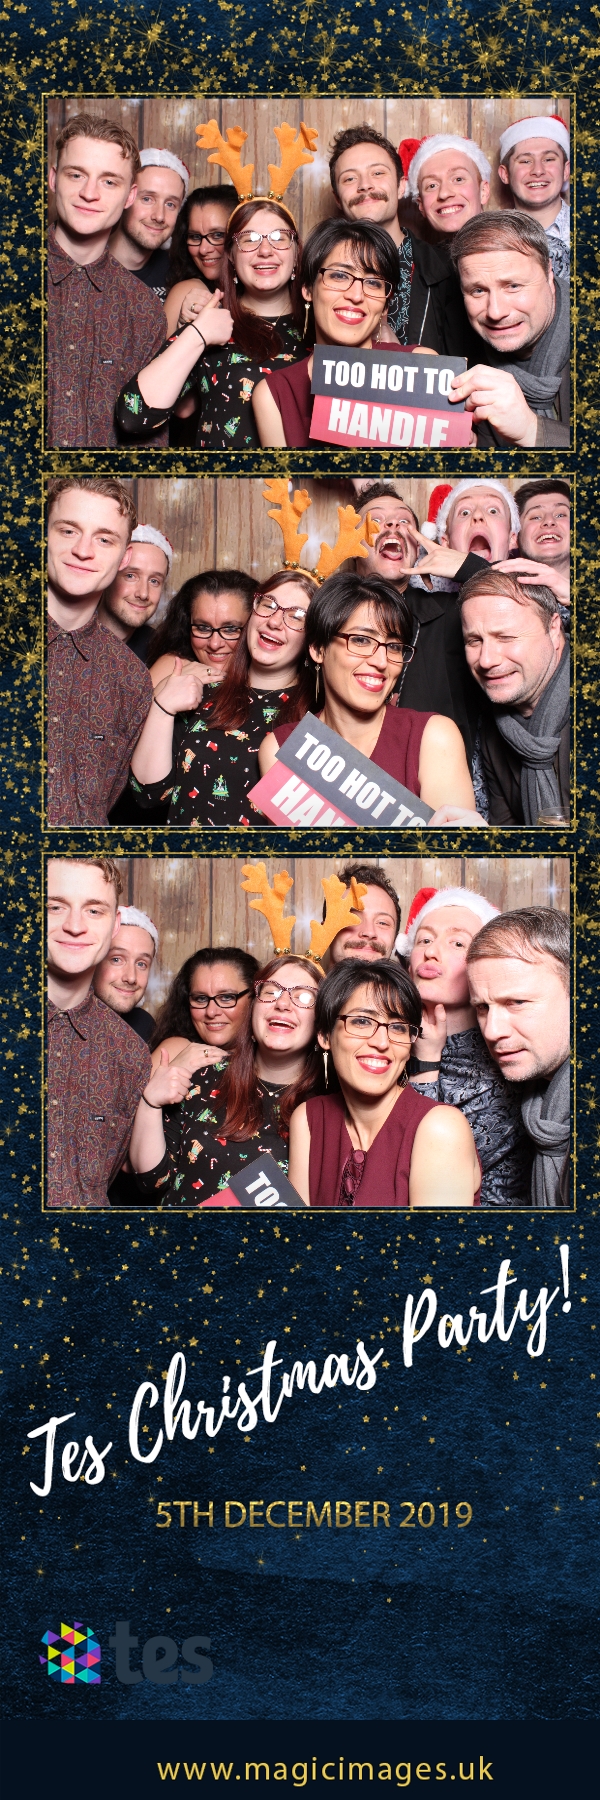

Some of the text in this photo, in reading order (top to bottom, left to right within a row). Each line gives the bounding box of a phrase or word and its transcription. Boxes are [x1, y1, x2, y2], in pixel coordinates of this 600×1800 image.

[322, 359, 456, 397] TOO HOT TO
[327, 397, 450, 447] HANDLE
[294, 731, 346, 783] TOO
[338, 768, 397, 820] HOT
[244, 1170, 288, 1206] TO
